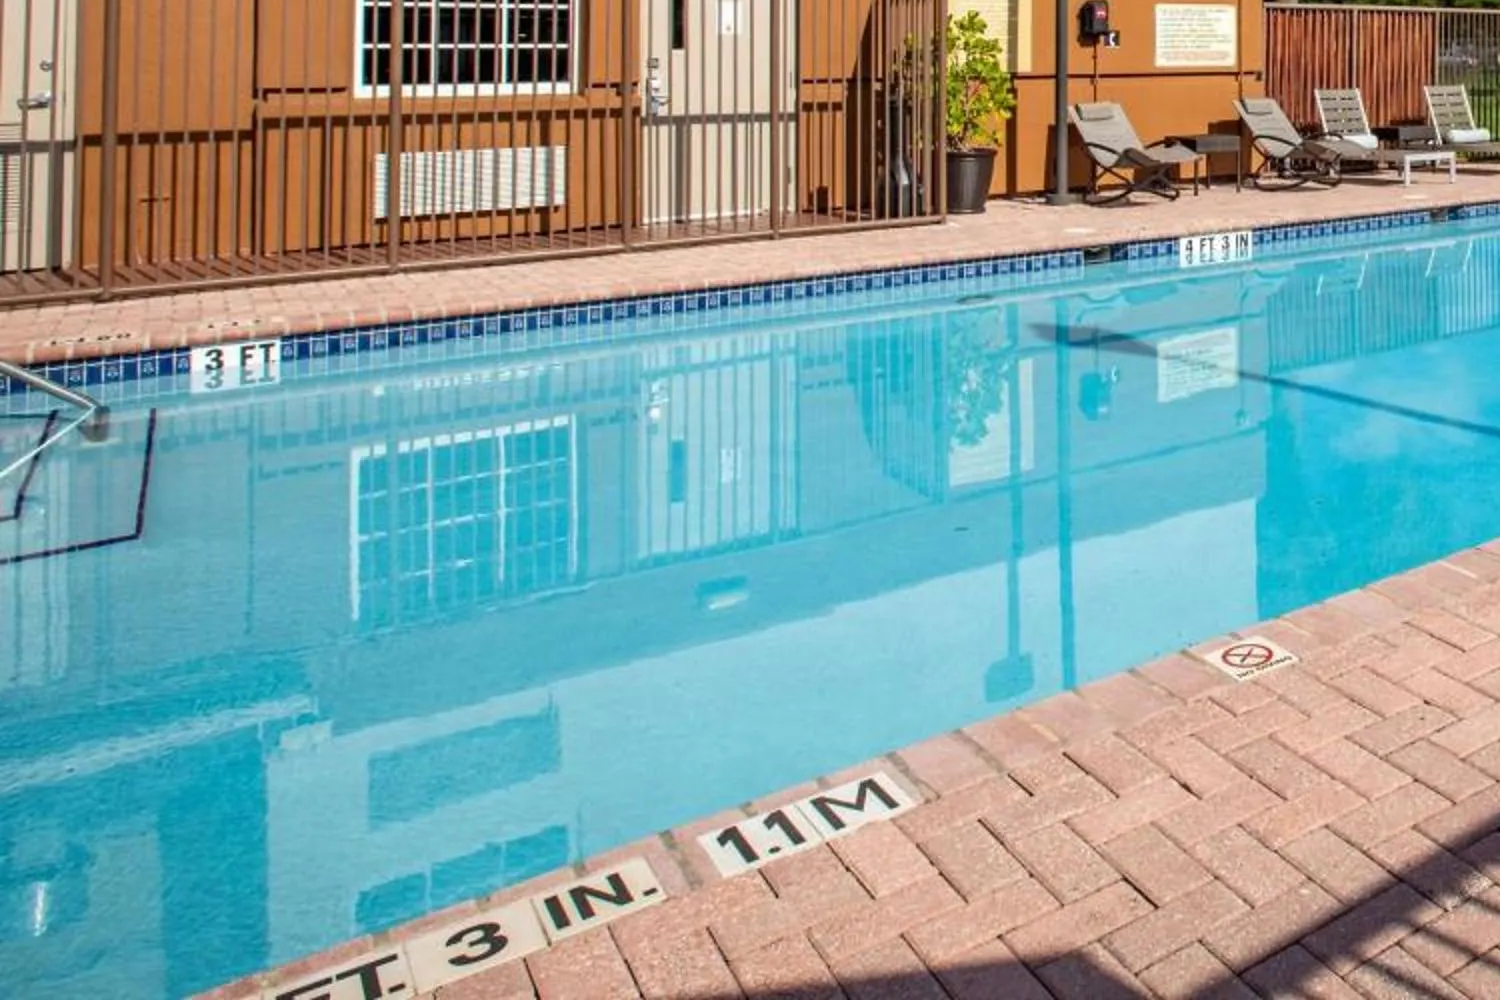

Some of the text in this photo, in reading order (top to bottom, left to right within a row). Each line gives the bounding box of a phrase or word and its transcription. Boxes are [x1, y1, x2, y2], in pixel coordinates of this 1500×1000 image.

[1185, 233, 1249, 251] 4 FT 3 IN
[204, 348, 224, 371] 3
[445, 922, 509, 969] 3
[542, 871, 659, 932] IN.
